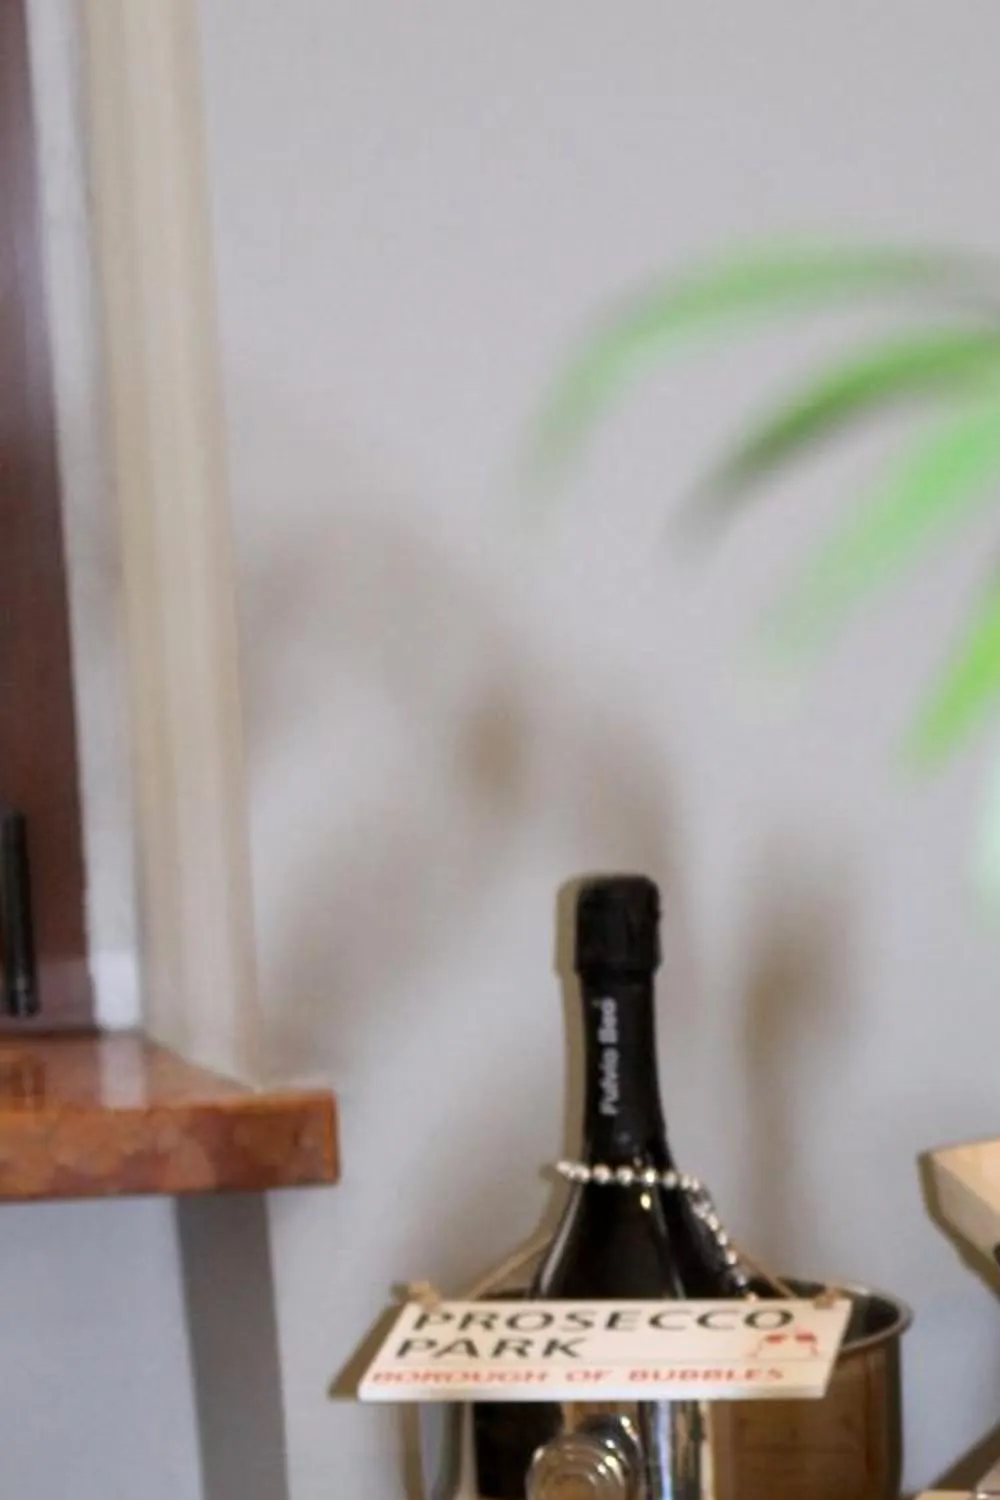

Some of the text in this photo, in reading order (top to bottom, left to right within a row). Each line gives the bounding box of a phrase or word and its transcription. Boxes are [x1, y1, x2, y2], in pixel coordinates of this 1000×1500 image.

[413, 1309, 795, 1332] PROSECCO
[396, 1336, 587, 1359] PARK
[371, 1367, 784, 1384] BOROUGH OF BUBBLES
